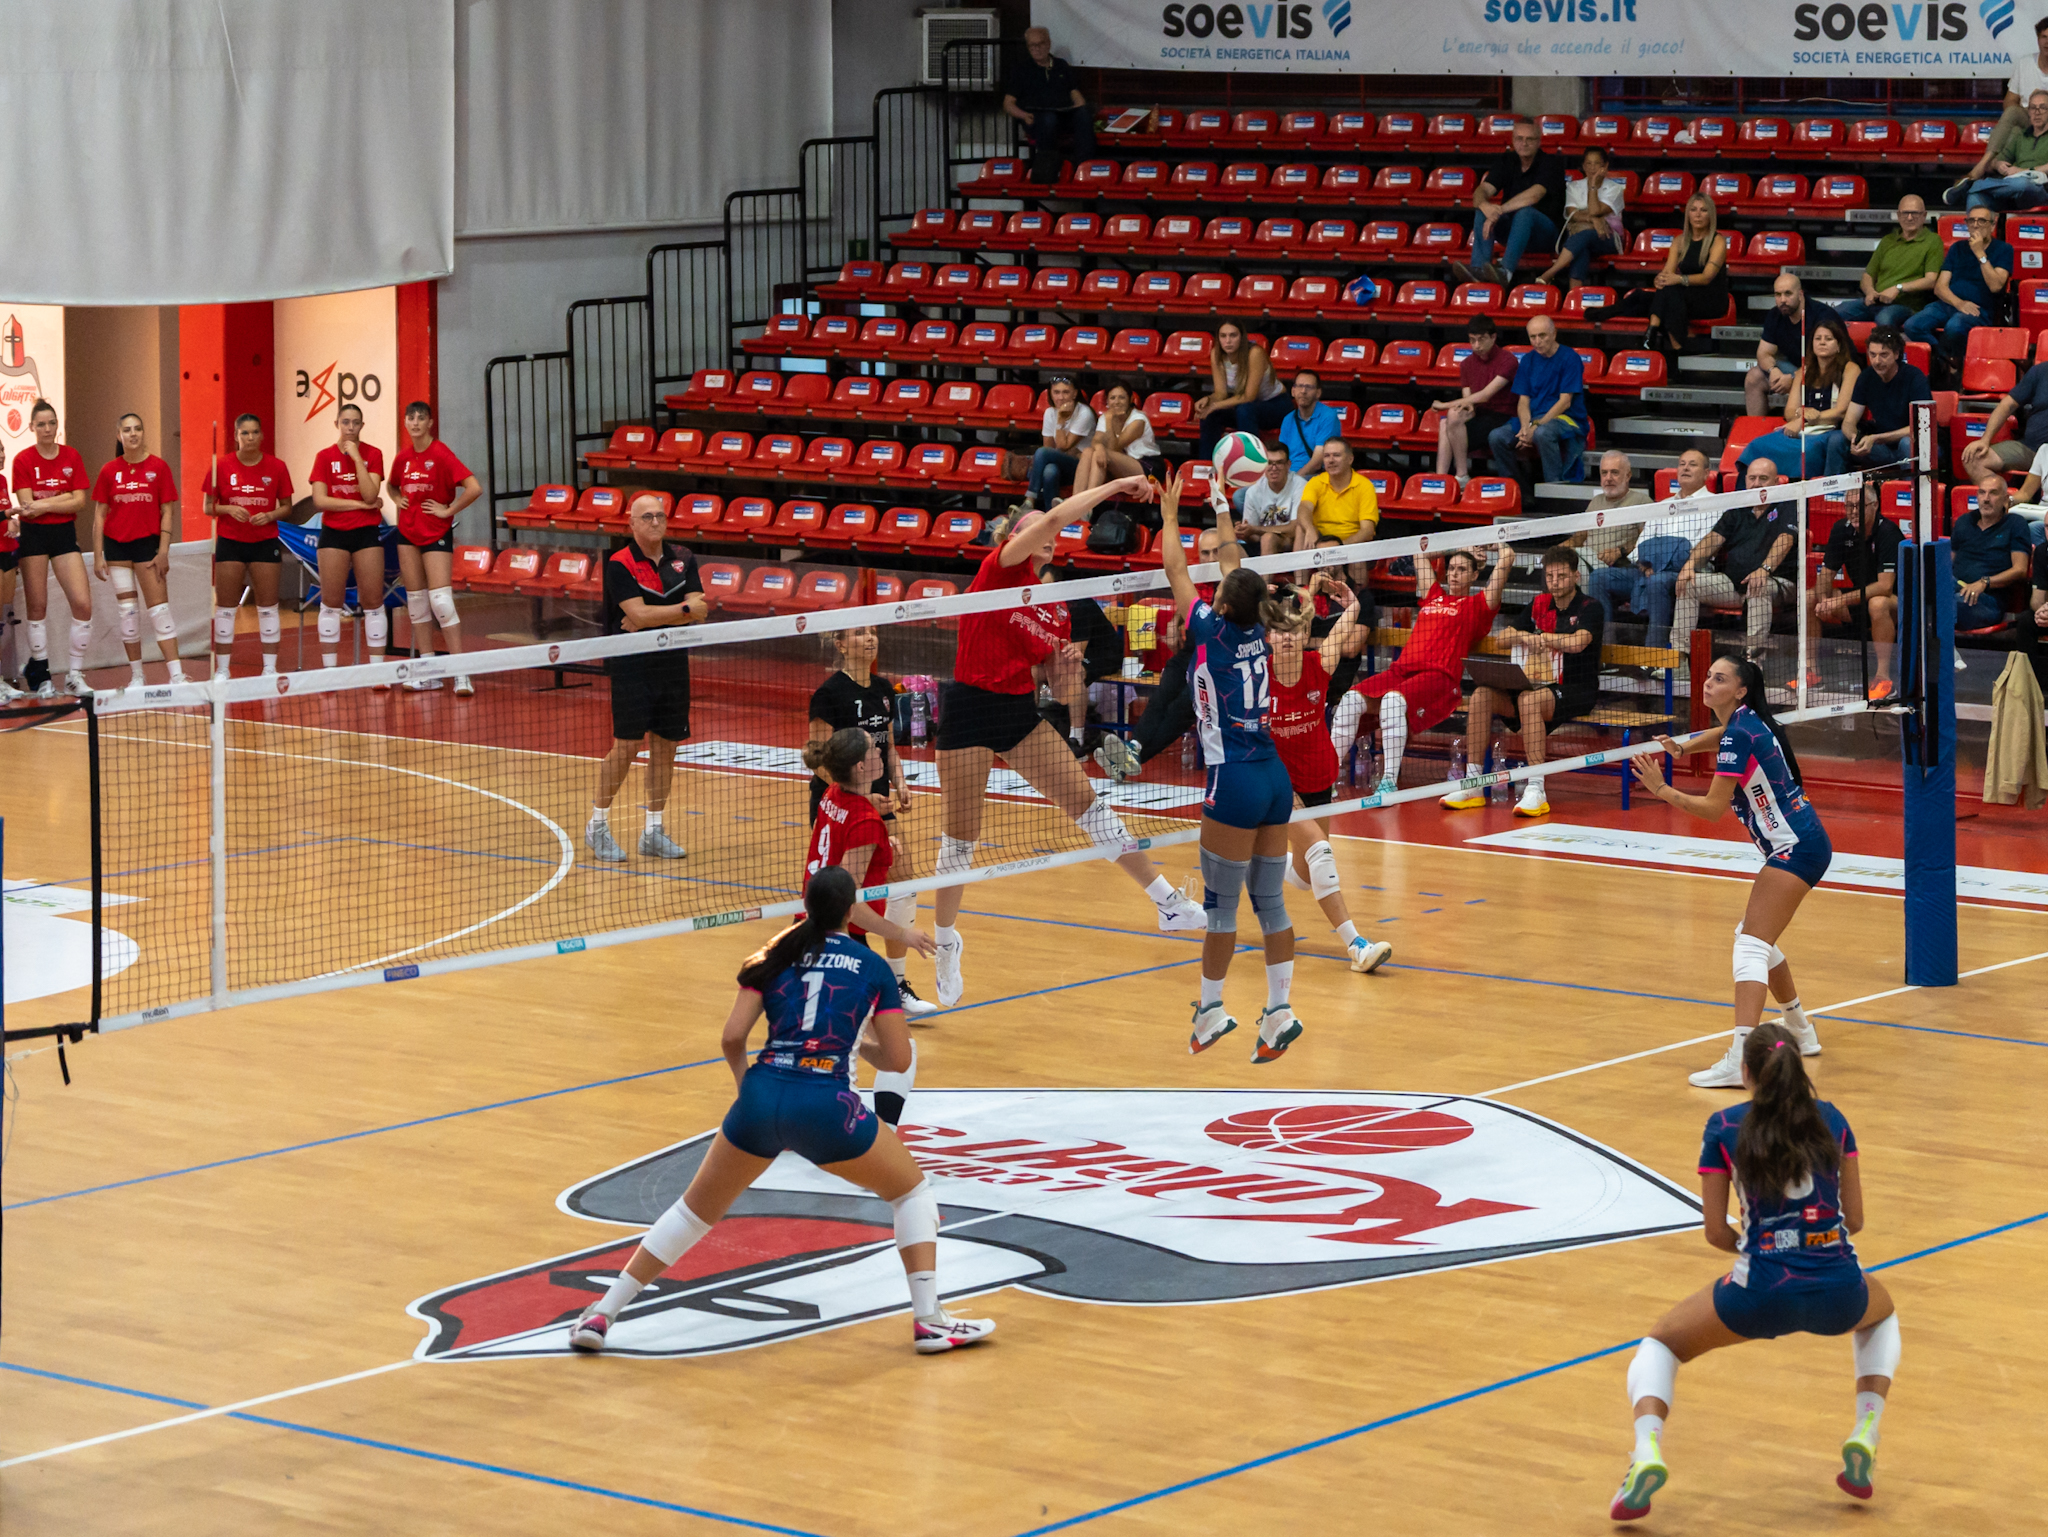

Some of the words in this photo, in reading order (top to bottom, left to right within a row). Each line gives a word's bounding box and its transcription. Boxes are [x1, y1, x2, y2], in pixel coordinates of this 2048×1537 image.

[1163, 0, 1313, 39] soevis
[1484, 0, 1637, 23] soevis.it
[1793, 0, 1968, 41] soevis
[1160, 45, 1211, 59] SOCIETÀ
[1216, 48, 1291, 61] ENERGETICA
[1296, 49, 1350, 61] ITALIANA
[1442, 37, 1509, 57] L'energia
[1517, 38, 1541, 54] che
[1551, 37, 1612, 54] accende
[1622, 38, 1630, 53] il
[1639, 38, 1685, 58] gioco!
[1793, 49, 1849, 64] SOCIETÀ
[1856, 52, 1943, 64] ENERGETICA
[1949, 52, 2013, 64] ITALIANA
[230, 474, 237, 486] 6
[1233, 655, 1270, 709] 12
[145, 689, 172, 698] molten
[854, 699, 863, 717] 7
[996, 863, 1016, 872] MASTER
[801, 971, 825, 1031] 1
[800, 1057, 834, 1072] FAIR
